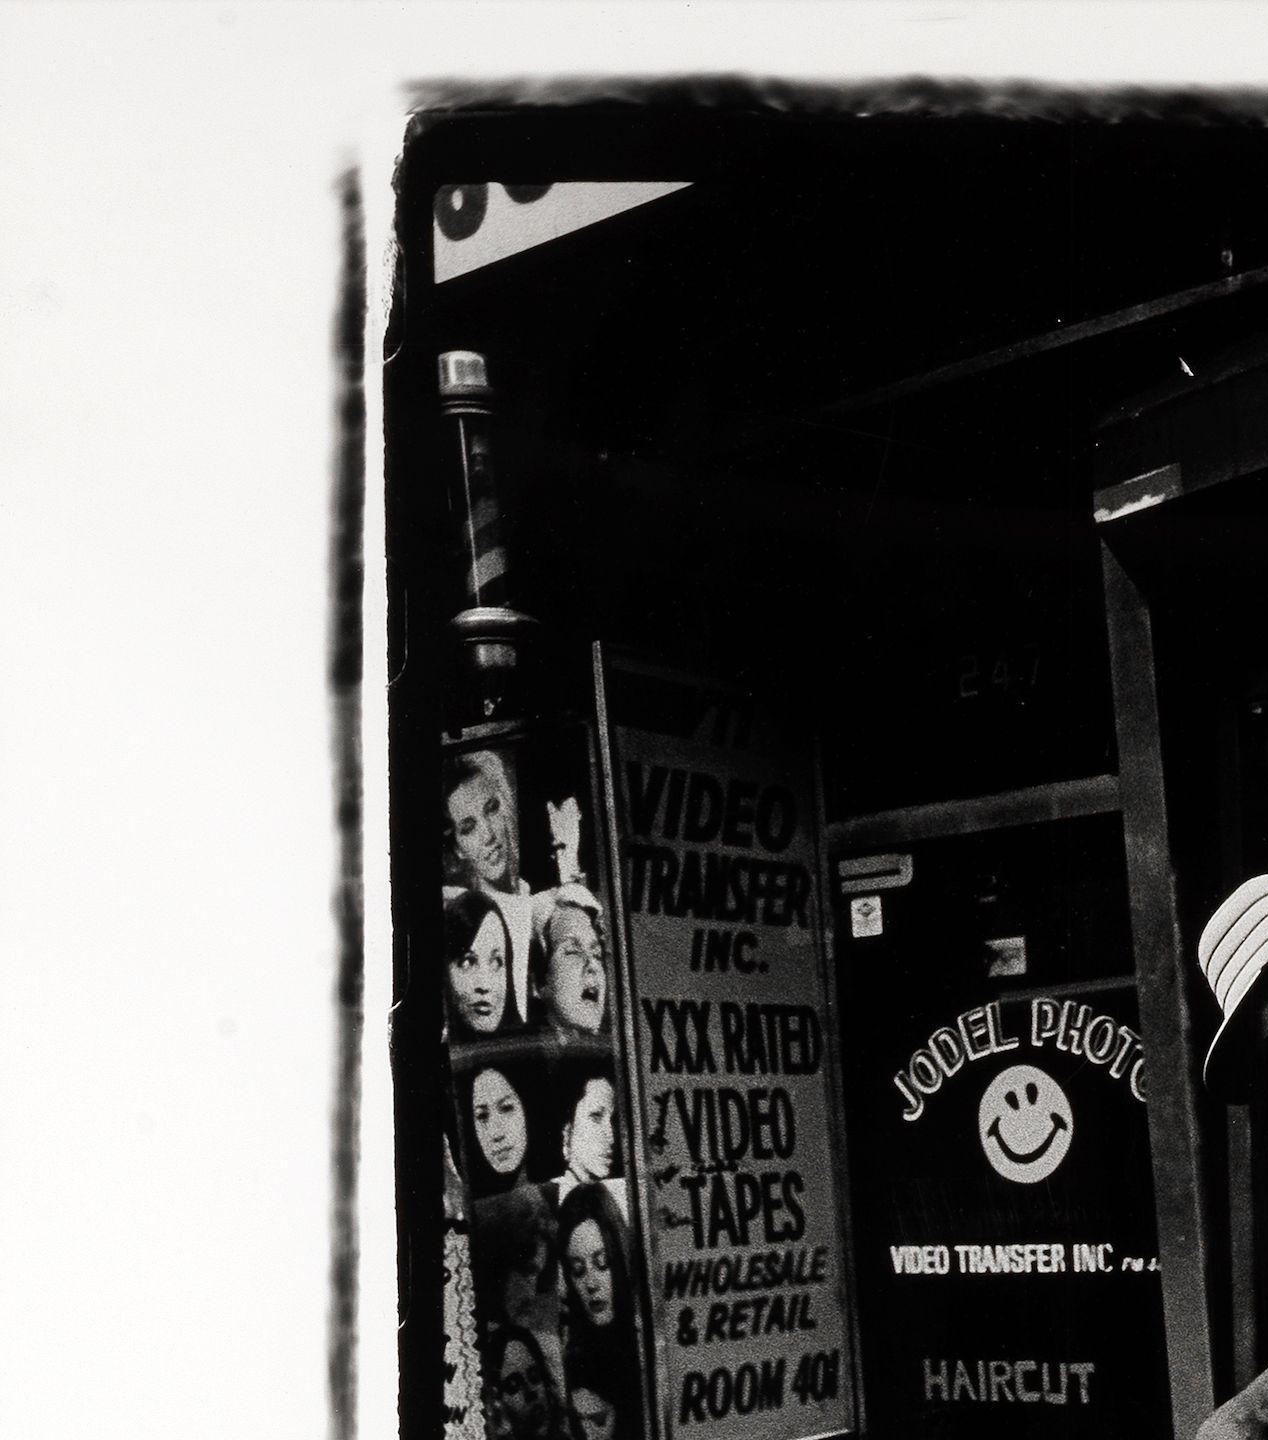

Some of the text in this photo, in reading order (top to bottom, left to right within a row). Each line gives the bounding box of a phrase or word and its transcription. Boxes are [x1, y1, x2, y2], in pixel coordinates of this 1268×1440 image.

[623, 760, 799, 852] VIDEO
[623, 845, 817, 928] TRANSFER
[691, 929, 770, 973] INC.
[641, 999, 821, 1075] XXX RATED
[894, 1000, 1019, 1122] JODEL
[674, 1087, 795, 1162] VIDEO
[680, 1172, 804, 1249] TAPES
[664, 1246, 827, 1299] WHOLESALE
[889, 1246, 949, 1276] VIDEO
[955, 1244, 1065, 1274] TRANSFER
[1073, 1243, 1113, 1272] INC
[677, 1296, 816, 1346] & RETAIL
[680, 1358, 786, 1424] ROOM
[922, 1358, 1096, 1404] HAIRCUT
